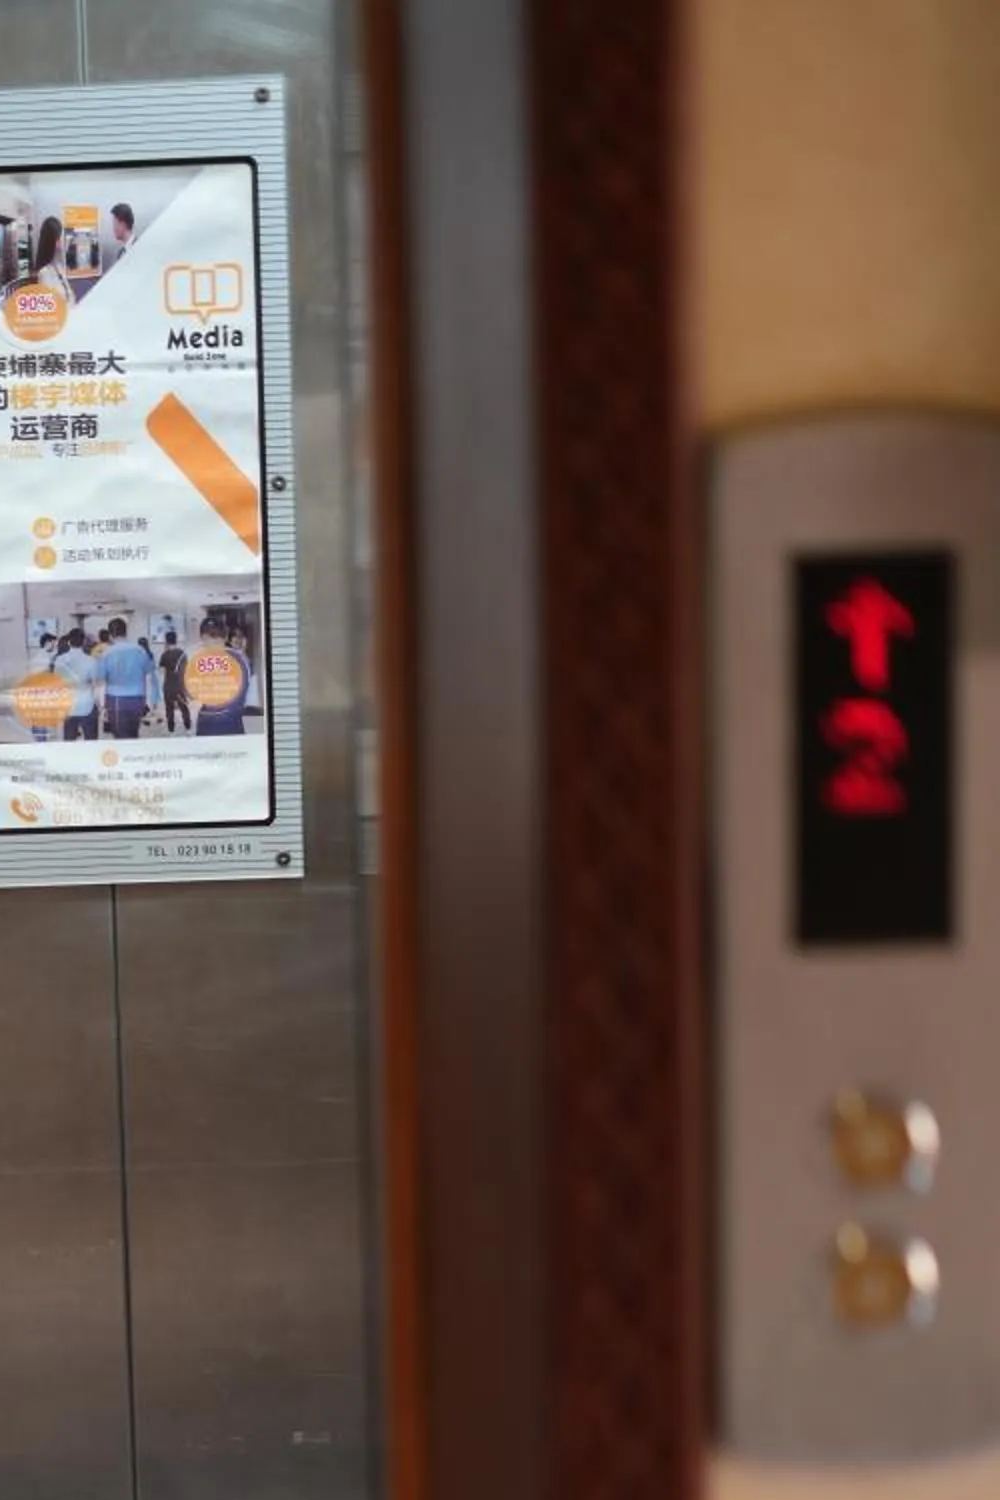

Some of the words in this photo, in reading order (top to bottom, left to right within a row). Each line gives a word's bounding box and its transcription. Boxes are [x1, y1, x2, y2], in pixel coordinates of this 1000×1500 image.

[18, 294, 55, 312] 90%
[166, 325, 243, 350] Media
[10, 412, 99, 441] 运营商
[819, 697, 910, 818] 2
